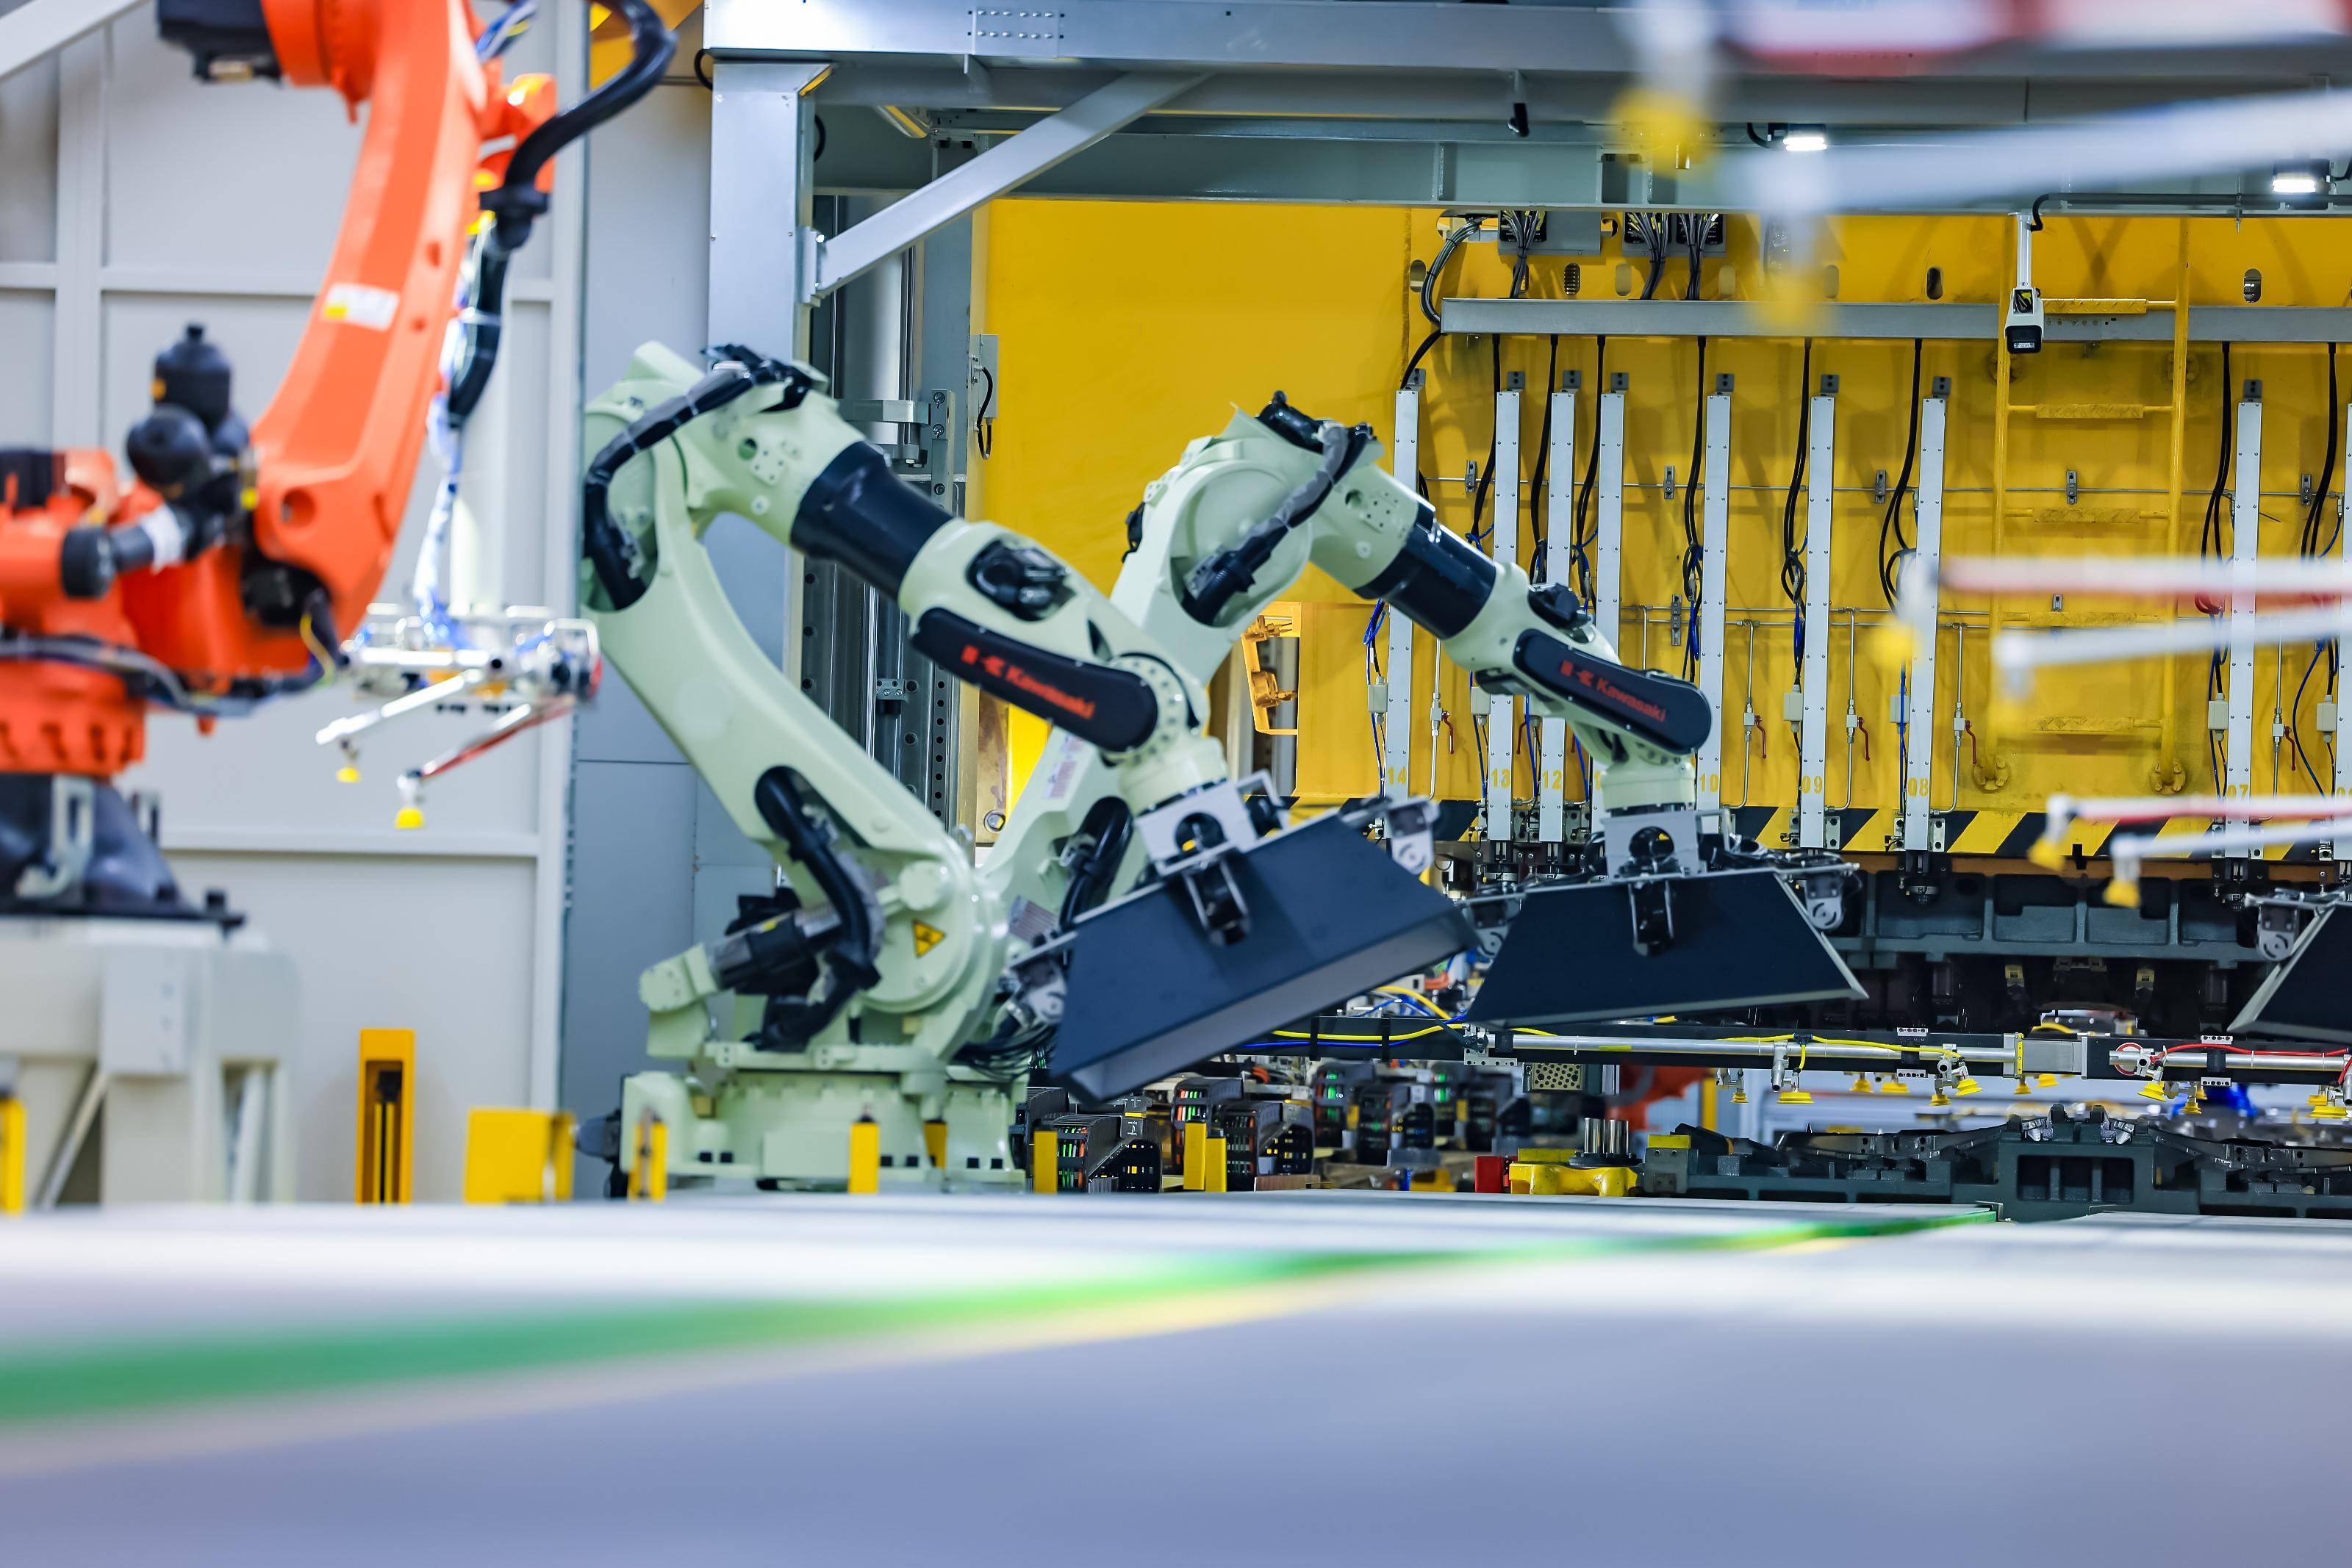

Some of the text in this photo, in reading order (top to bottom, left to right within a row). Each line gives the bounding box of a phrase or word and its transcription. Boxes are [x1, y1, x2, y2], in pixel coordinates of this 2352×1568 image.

[1596, 677, 1666, 722] Kawasaki
[1387, 766, 1407, 785] 14
[1491, 769, 1511, 788] 13
[1543, 770, 1562, 790] 12
[1699, 774, 1718, 792] 10
[1801, 775, 1823, 794] 09
[1908, 777, 1929, 797] 08
